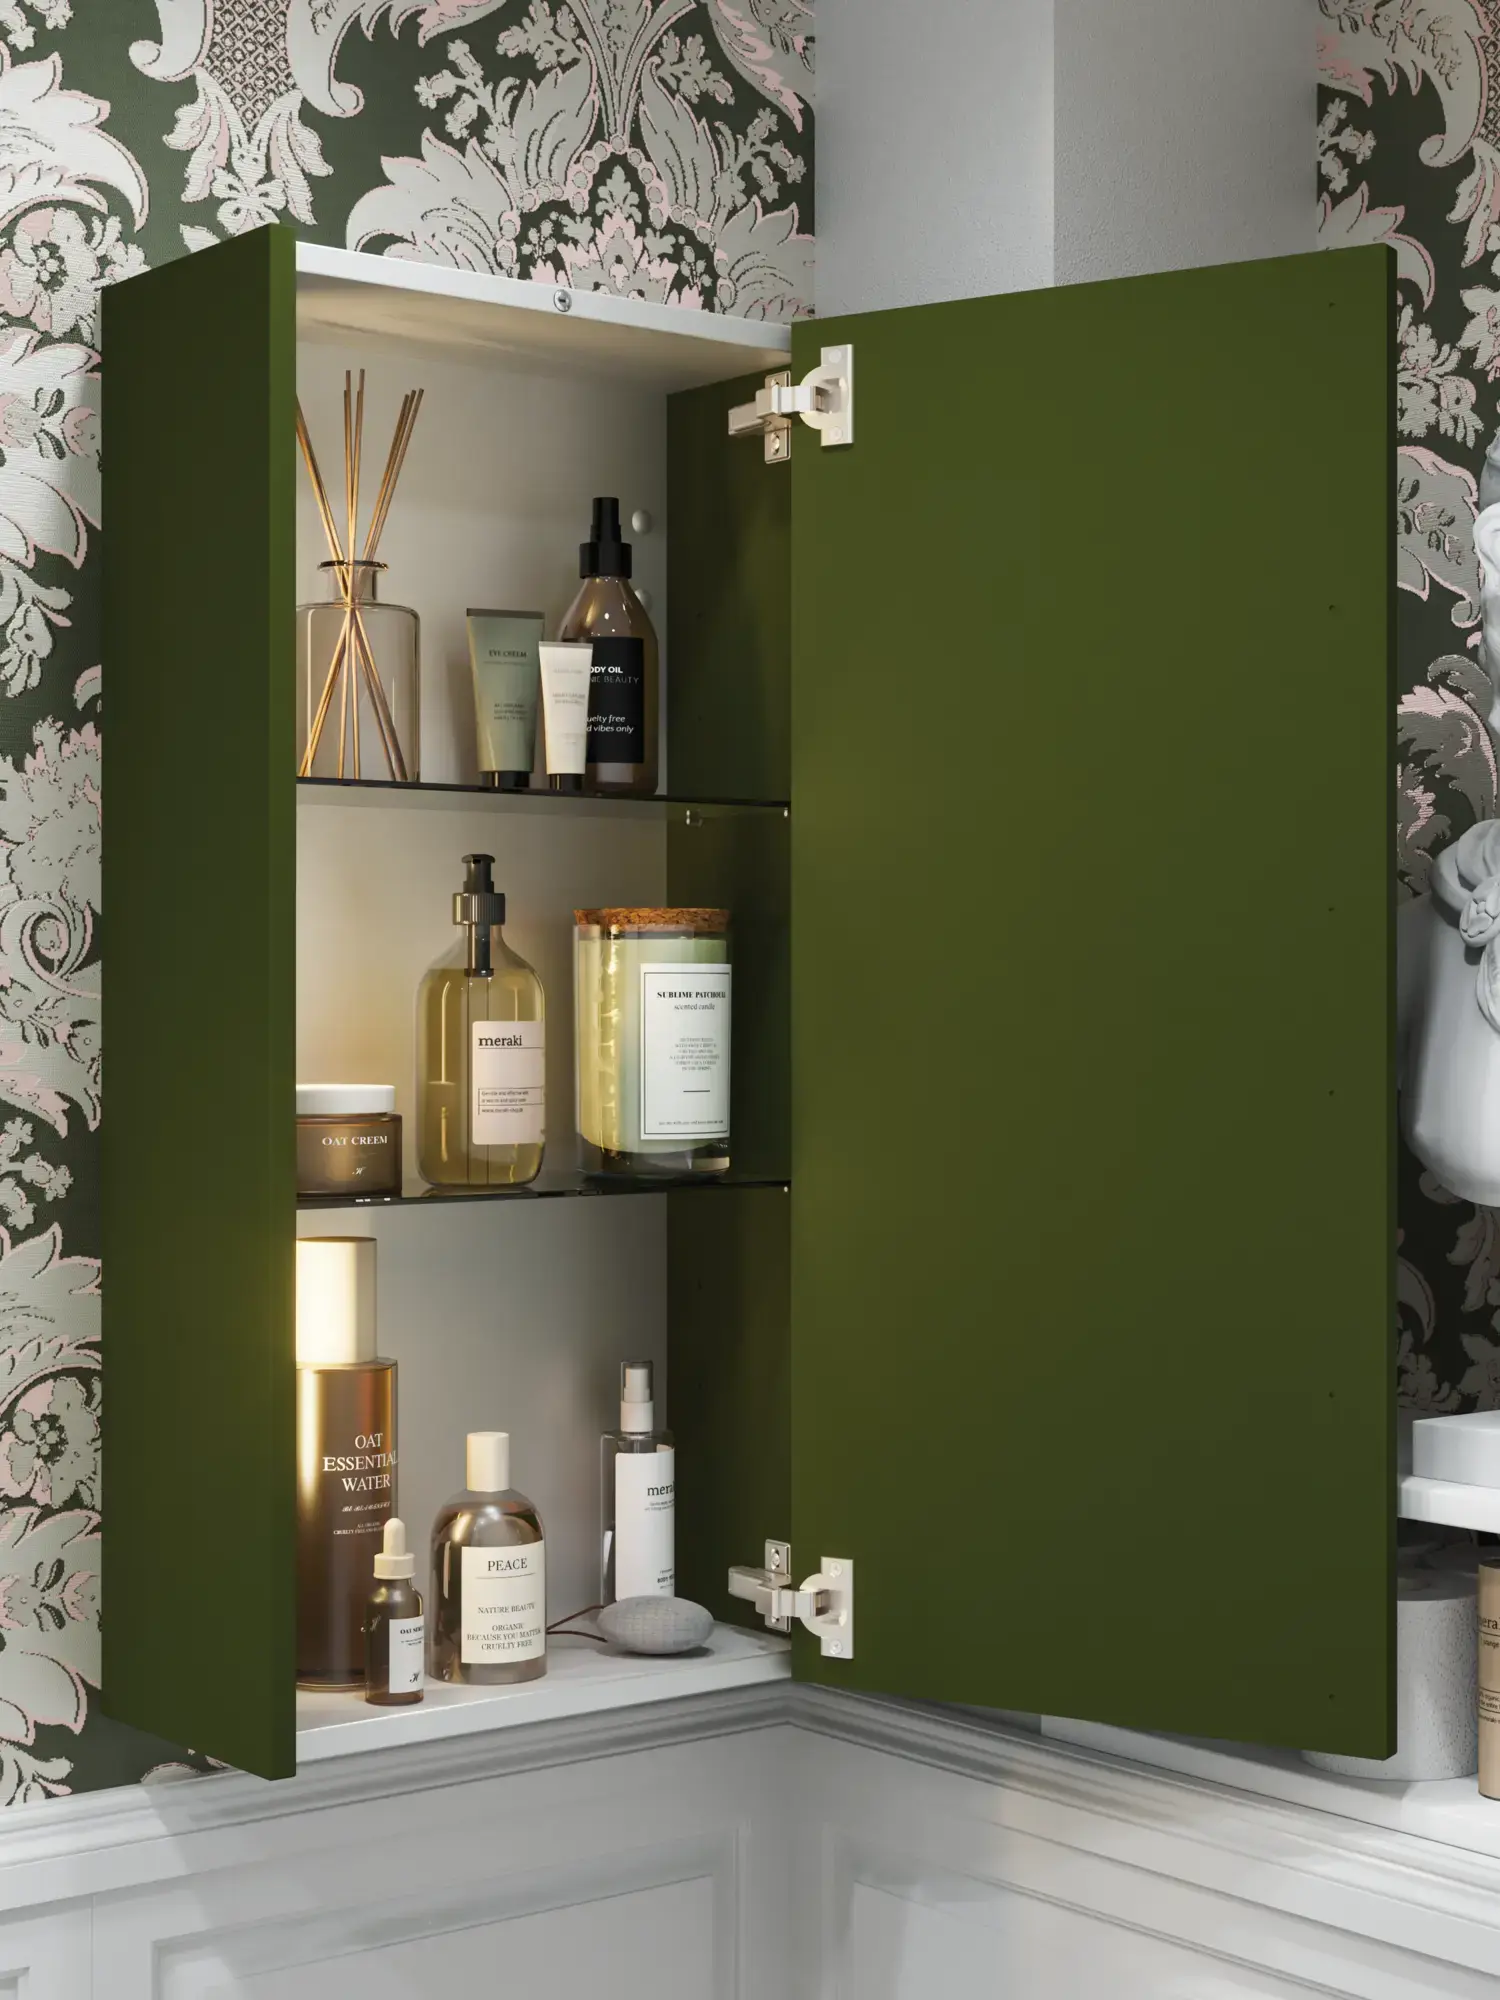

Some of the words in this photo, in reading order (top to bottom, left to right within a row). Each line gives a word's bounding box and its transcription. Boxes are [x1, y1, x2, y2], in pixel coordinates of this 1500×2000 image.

[604, 676, 639, 684] BEAUTY
[587, 715, 607, 723] uelty
[609, 715, 625, 723] free
[616, 725, 634, 734] only
[478, 1035, 522, 1046] meraki
[322, 1137, 348, 1146] OAT
[351, 1136, 388, 1145] CREEM
[355, 1433, 383, 1449] OAT
[322, 1451, 398, 1471] ESSENTIAL
[342, 1474, 391, 1491] WATER
[487, 1558, 528, 1571] PEACE
[478, 1606, 509, 1614] NATURE
[511, 1602, 535, 1612] BEAUTY
[503, 1632, 518, 1640] YOU
[481, 1642, 515, 1650] CRUELTY
[517, 1639, 532, 1647] FREE
